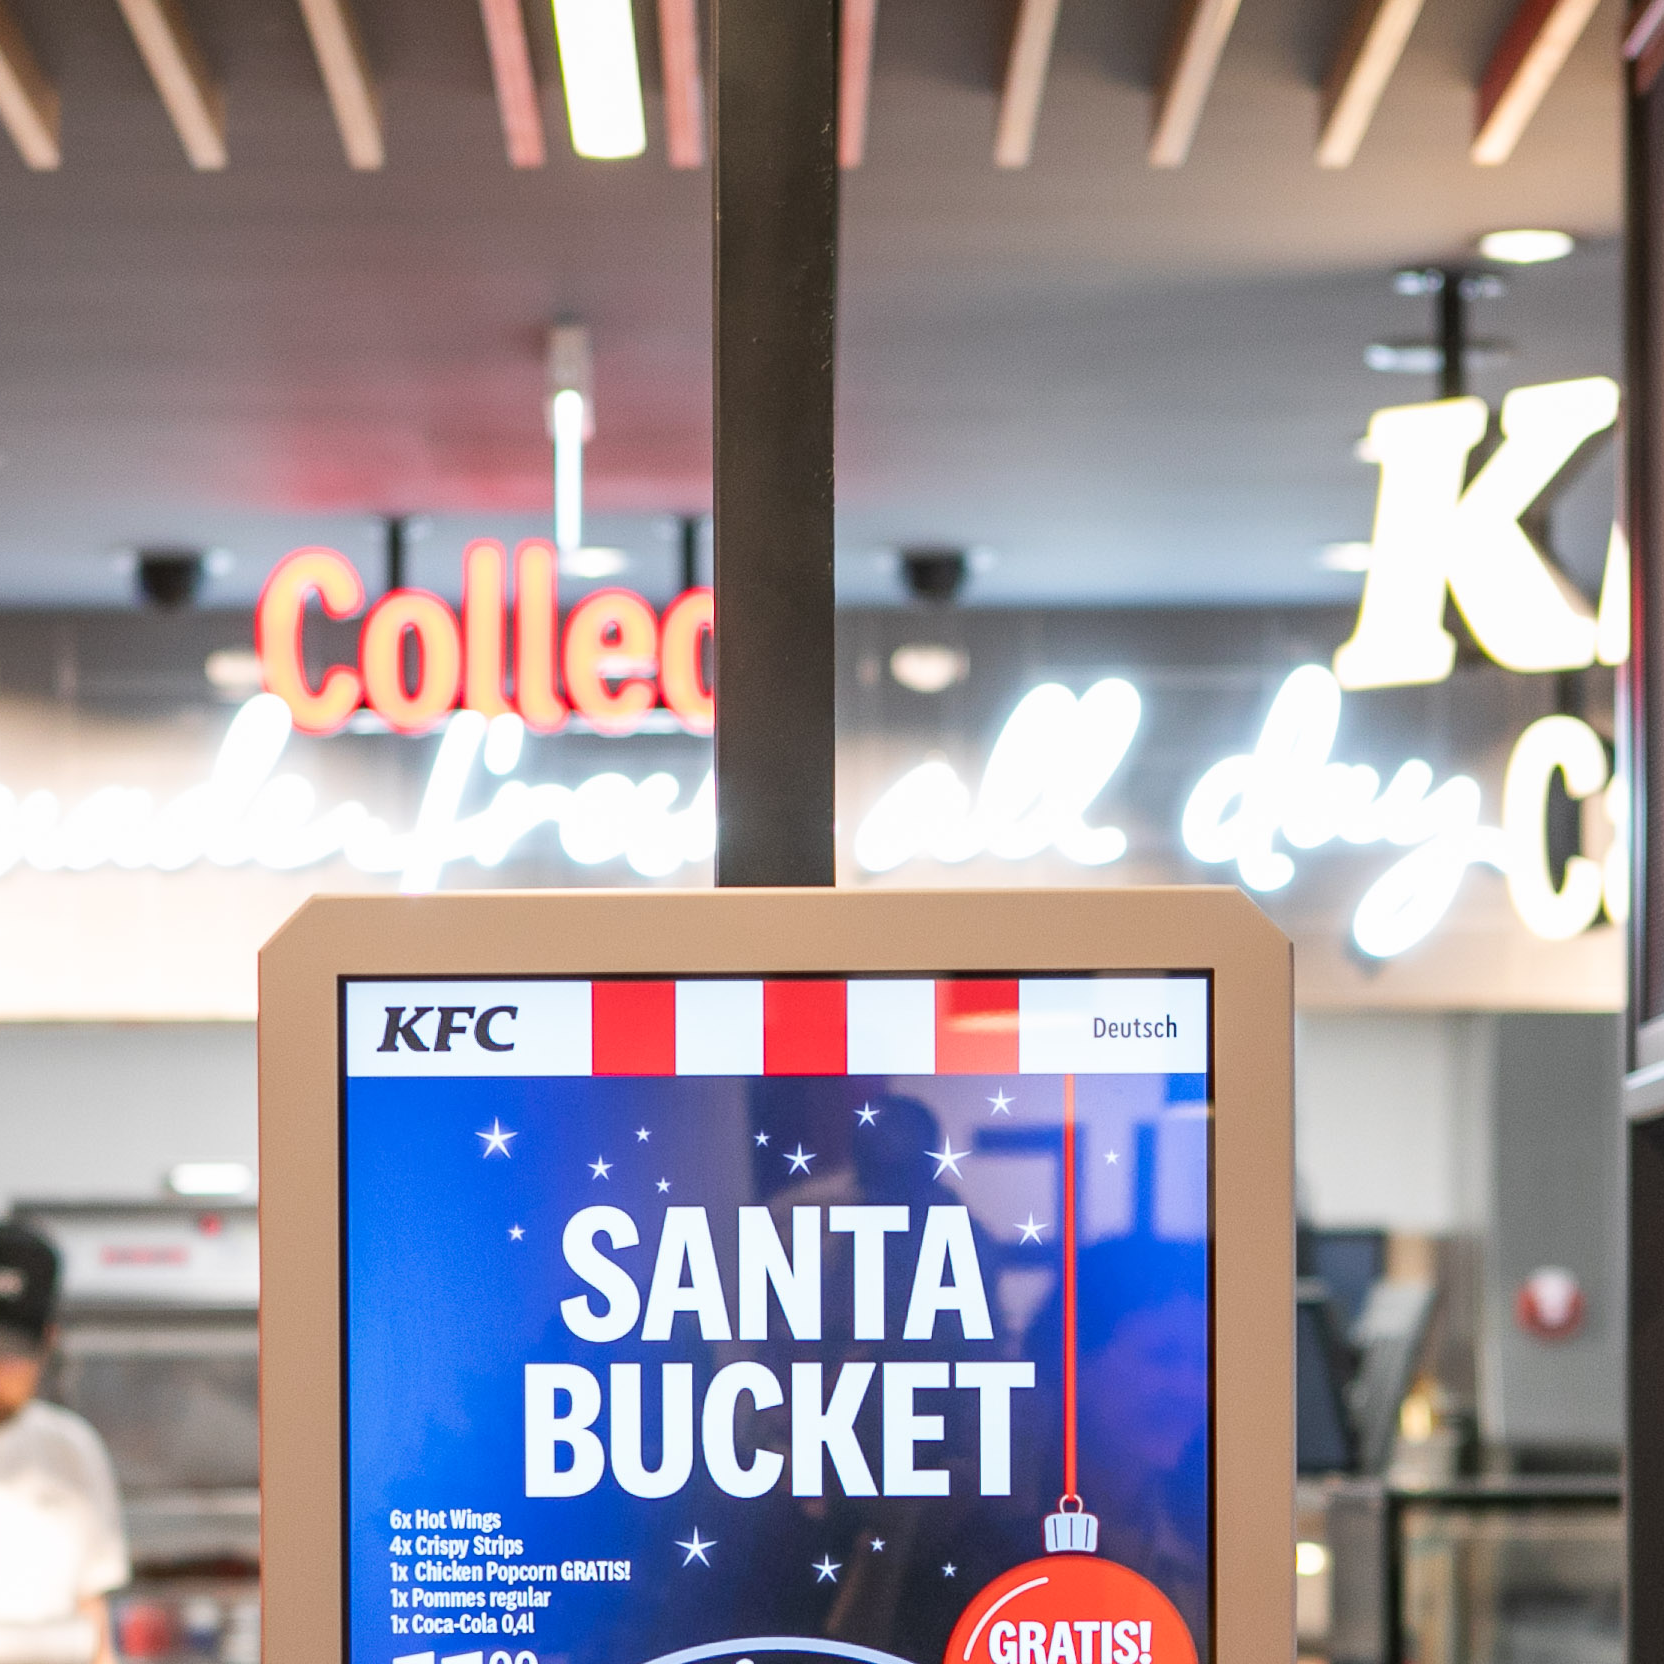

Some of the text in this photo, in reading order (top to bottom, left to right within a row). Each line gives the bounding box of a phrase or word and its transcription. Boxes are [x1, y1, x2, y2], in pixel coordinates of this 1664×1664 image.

[854, 677, 1142, 872] all
[1182, 663, 1487, 957] day
[376, 1005, 519, 1053] KFC
[1093, 1013, 1178, 1039] Deutsch
[558, 1204, 995, 1344] SANTA
[524, 1360, 1036, 1499] BUCKET
[389, 1508, 502, 1534] 6x Hot Wings
[388, 1534, 524, 1560] 4x Crispy Strips
[389, 1559, 631, 1586] 1x Chicken Popcorn GRATIS!
[389, 1585, 552, 1612] 1x Pommes regular
[390, 1611, 535, 1637] 1x Coca-Cola 0,4l
